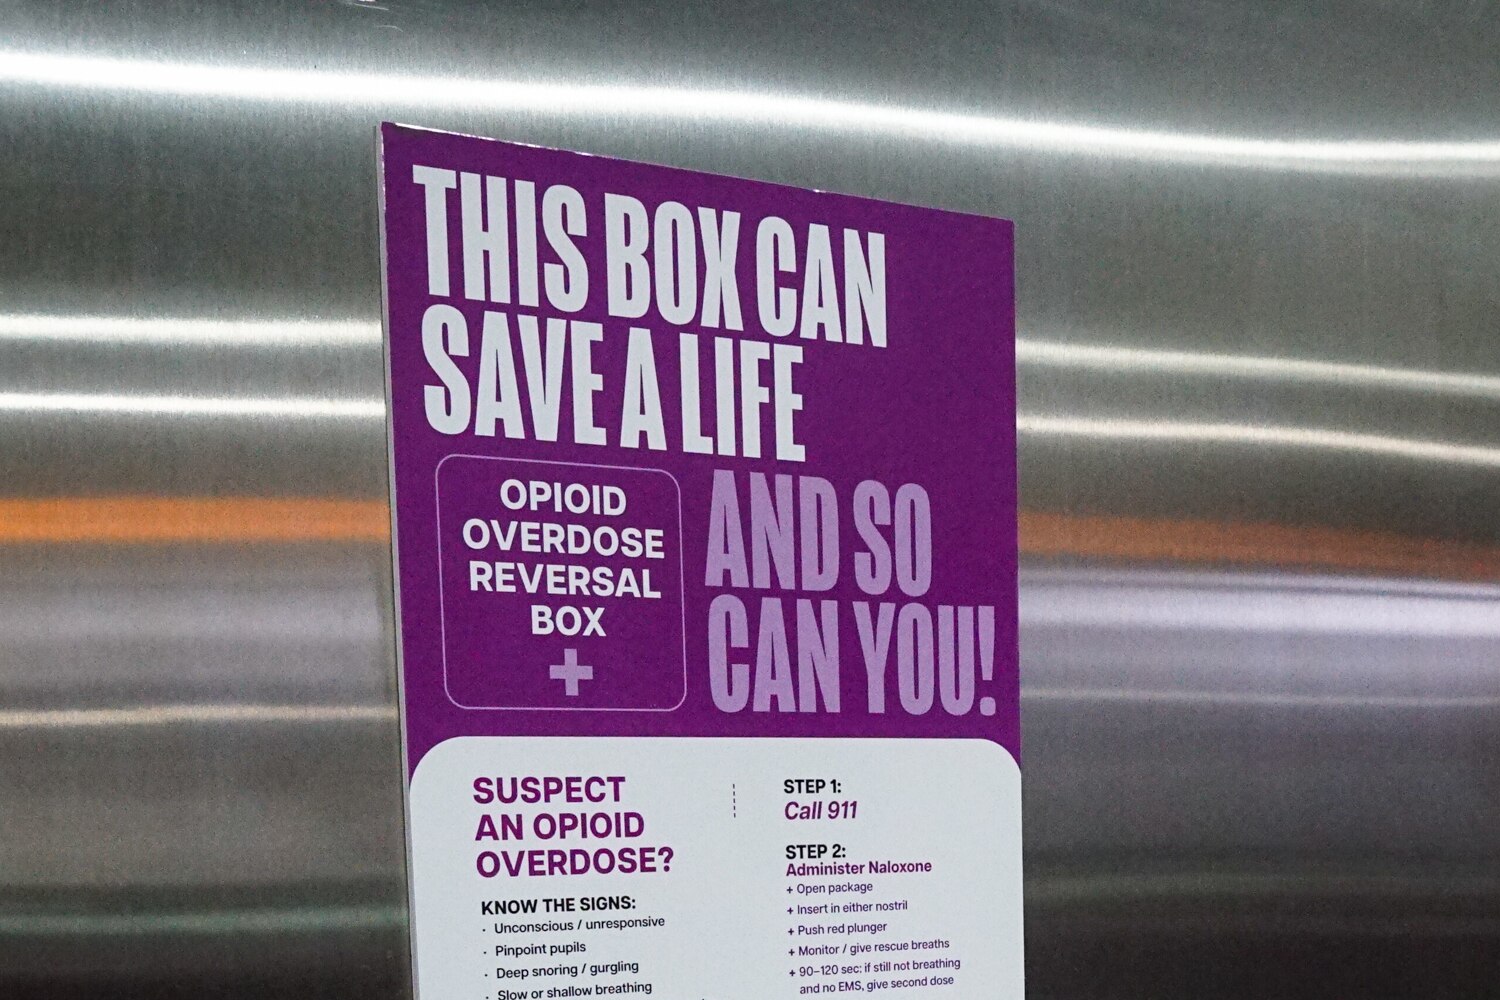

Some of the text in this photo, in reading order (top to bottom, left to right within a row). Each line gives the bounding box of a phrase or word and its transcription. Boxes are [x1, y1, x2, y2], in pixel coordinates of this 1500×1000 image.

[412, 164, 887, 348] THIS BOX CAN
[421, 303, 806, 462] SAVE A LIFE
[500, 478, 626, 516] OPIOID
[462, 518, 665, 558] OVERDOSE
[704, 469, 933, 598] AND SO
[469, 560, 661, 598] REVERSAL
[530, 604, 607, 637] BOX
[707, 594, 997, 717] CAN YOU!
[473, 776, 625, 804] SUSPECT
[784, 779, 841, 794] STEP 1:
[784, 800, 857, 820] Call 911
[475, 812, 644, 841] AN OPIOID
[786, 844, 846, 859] STEP 2:
[476, 846, 674, 878] OVERDOSE?
[786, 861, 932, 876] Administer Naloxone
[797, 882, 873, 896] Open package
[481, 896, 636, 915] KNOW THE SIGNS:
[798, 900, 908, 914] Insert in either nostril
[495, 916, 665, 934] Unconscious unresponsive
[798, 922, 887, 935] Push red plunger
[496, 941, 586, 958] Pinpoint pupils
[798, 939, 949, 956] Monitor give rescue breaths
[497, 961, 639, 980] Deep snoring gurgling
[841, 964, 862, 974] sec:
[865, 963, 870, 972] if
[874, 961, 891, 972] still
[894, 960, 910, 971] not
[913, 958, 960, 970] breathing
[498, 981, 652, 1000] Slow or shallow breathing
[800, 984, 820, 994] and
[839, 981, 864, 992] EMS,
[867, 979, 888, 992] give
[891, 977, 927, 988] second
[930, 976, 954, 985] dose
